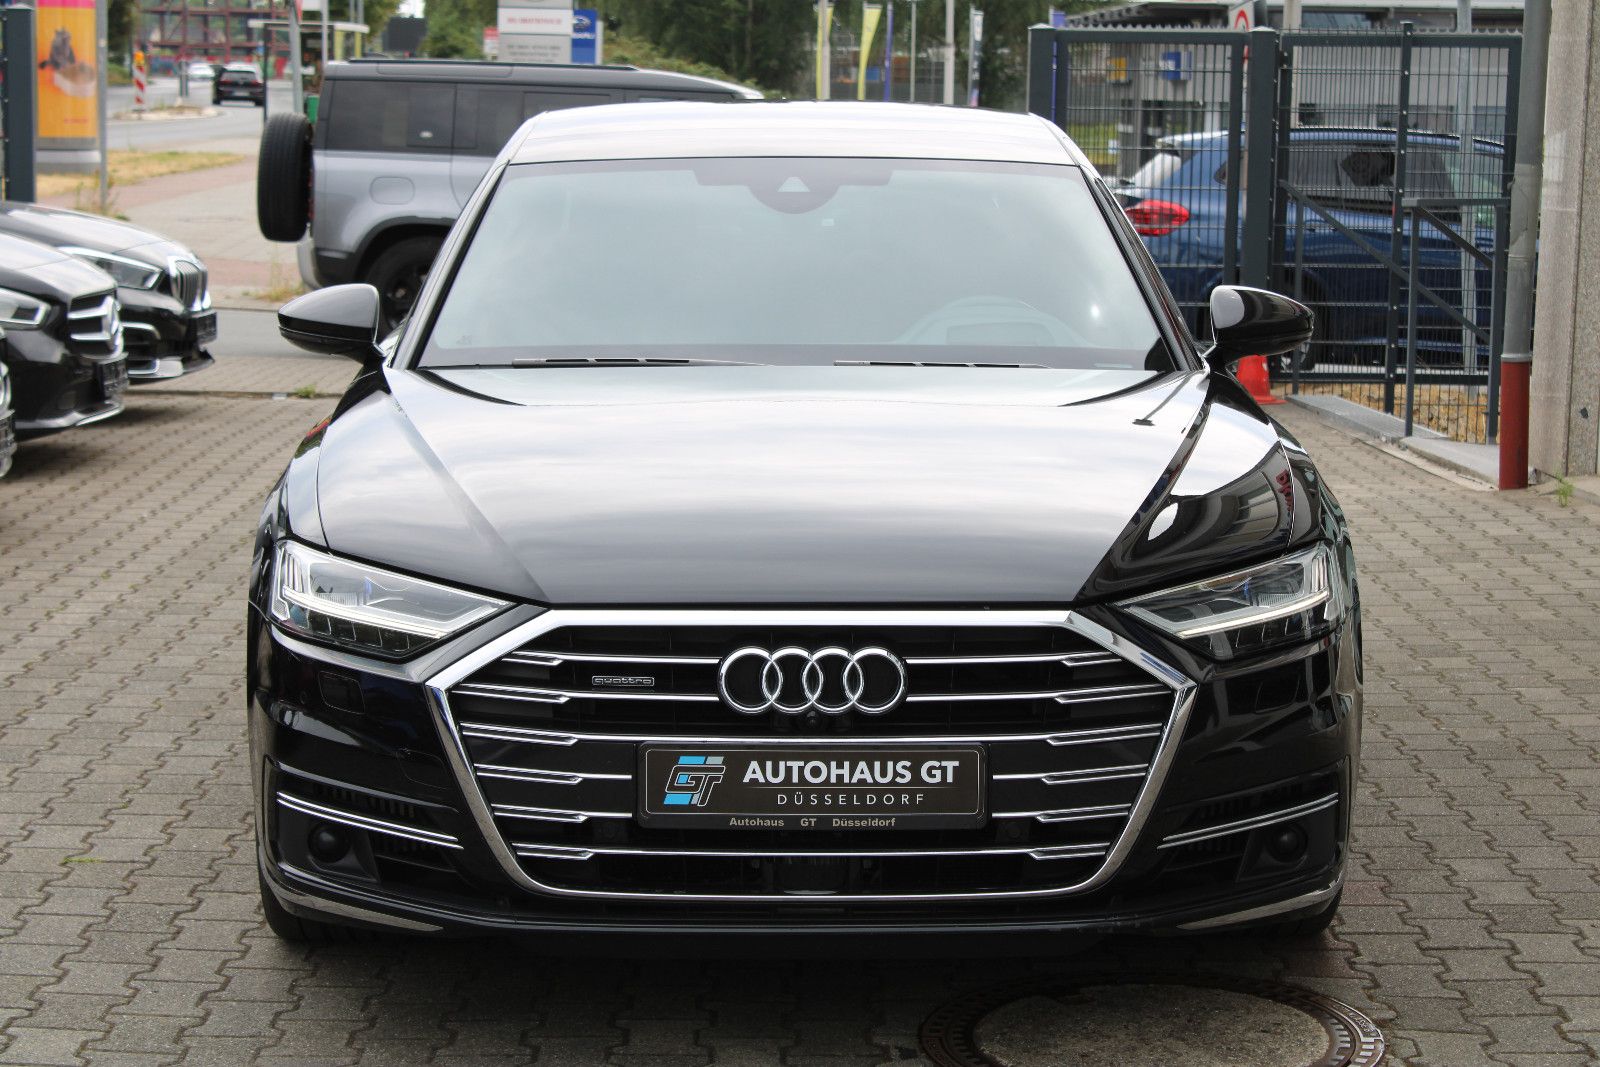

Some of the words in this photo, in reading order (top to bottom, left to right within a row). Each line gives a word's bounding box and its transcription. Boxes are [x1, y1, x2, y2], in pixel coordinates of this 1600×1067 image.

[594, 677, 652, 685] quattro
[742, 760, 912, 784] AUTOHAUS
[920, 760, 960, 784] GT
[777, 791, 924, 805] DÜSSELDORF
[729, 817, 785, 827] Autohaus
[800, 818, 817, 827] GT
[832, 817, 896, 827] Düsseldorf
